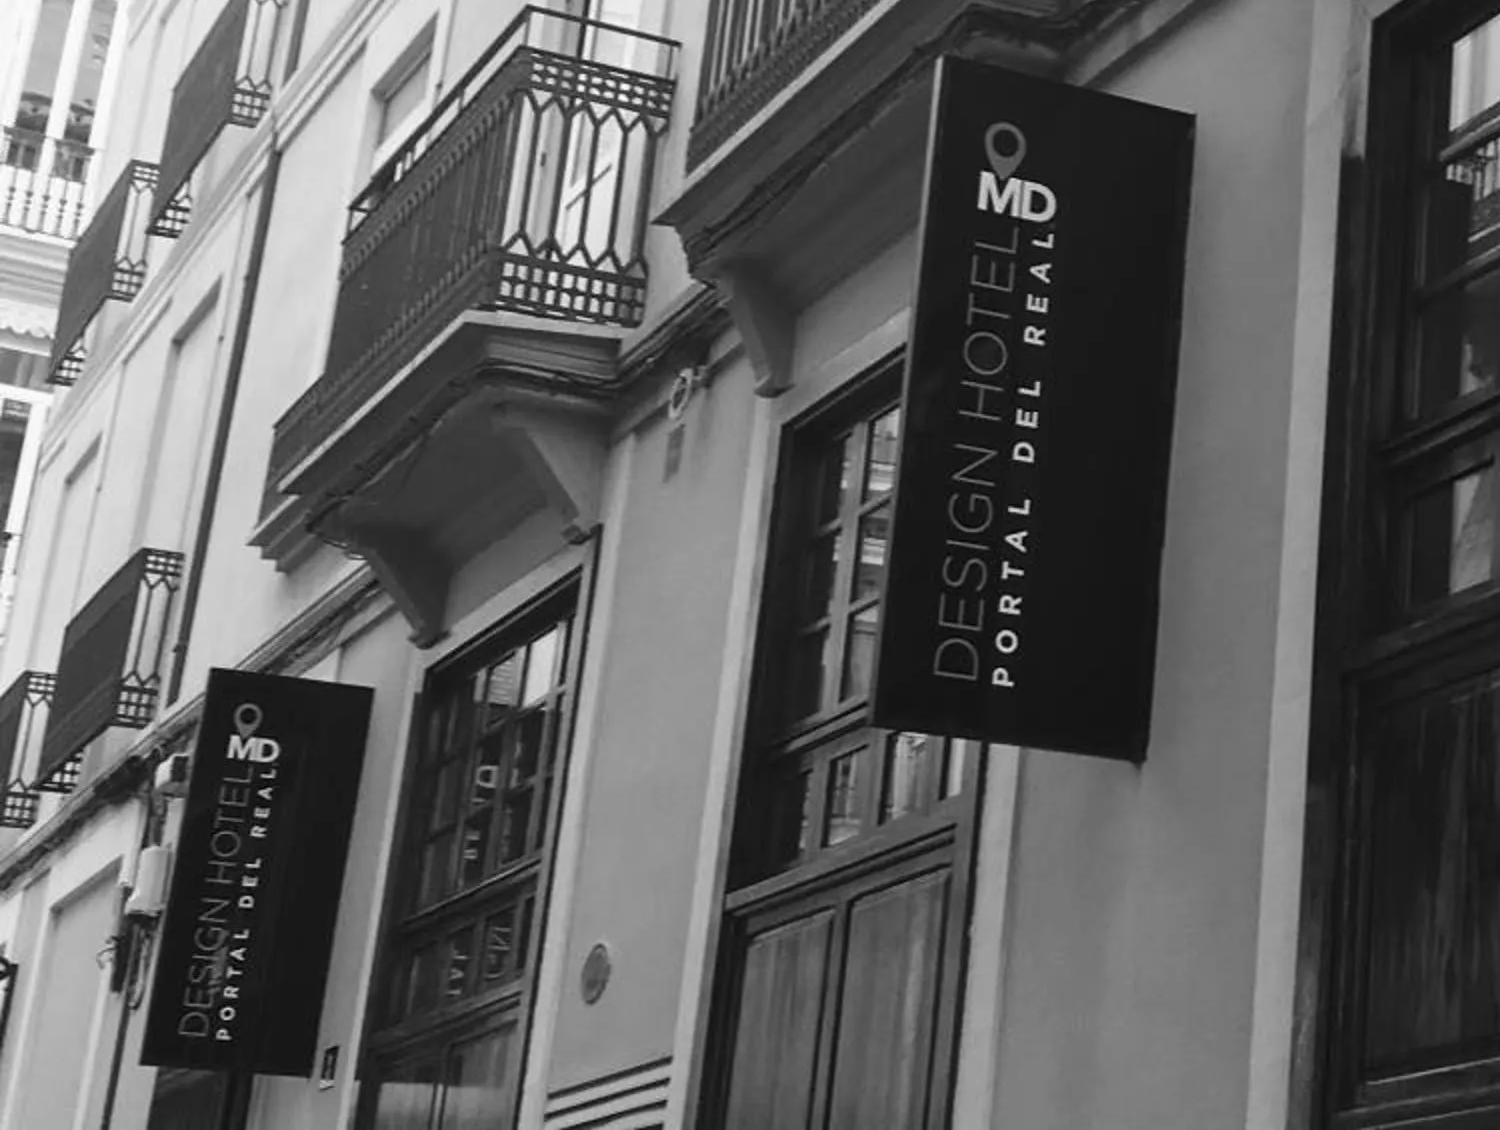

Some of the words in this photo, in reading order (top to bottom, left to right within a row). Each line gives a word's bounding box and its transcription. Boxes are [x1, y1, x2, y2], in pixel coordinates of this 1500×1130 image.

[977, 171, 1057, 223] MD
[959, 227, 1020, 422] HOTEL
[1023, 233, 1055, 347] REAL
[1012, 380, 1042, 464] DEL
[934, 444, 998, 681] DESIGN
[992, 499, 1032, 688] PORTAL
[226, 735, 281, 763] MD
[249, 768, 277, 839] REAL
[178, 897, 231, 1038] DESIGN
[206, 766, 254, 885] HOTEL
[238, 858, 263, 909] DEL
[215, 928, 251, 1041] PORTAL
